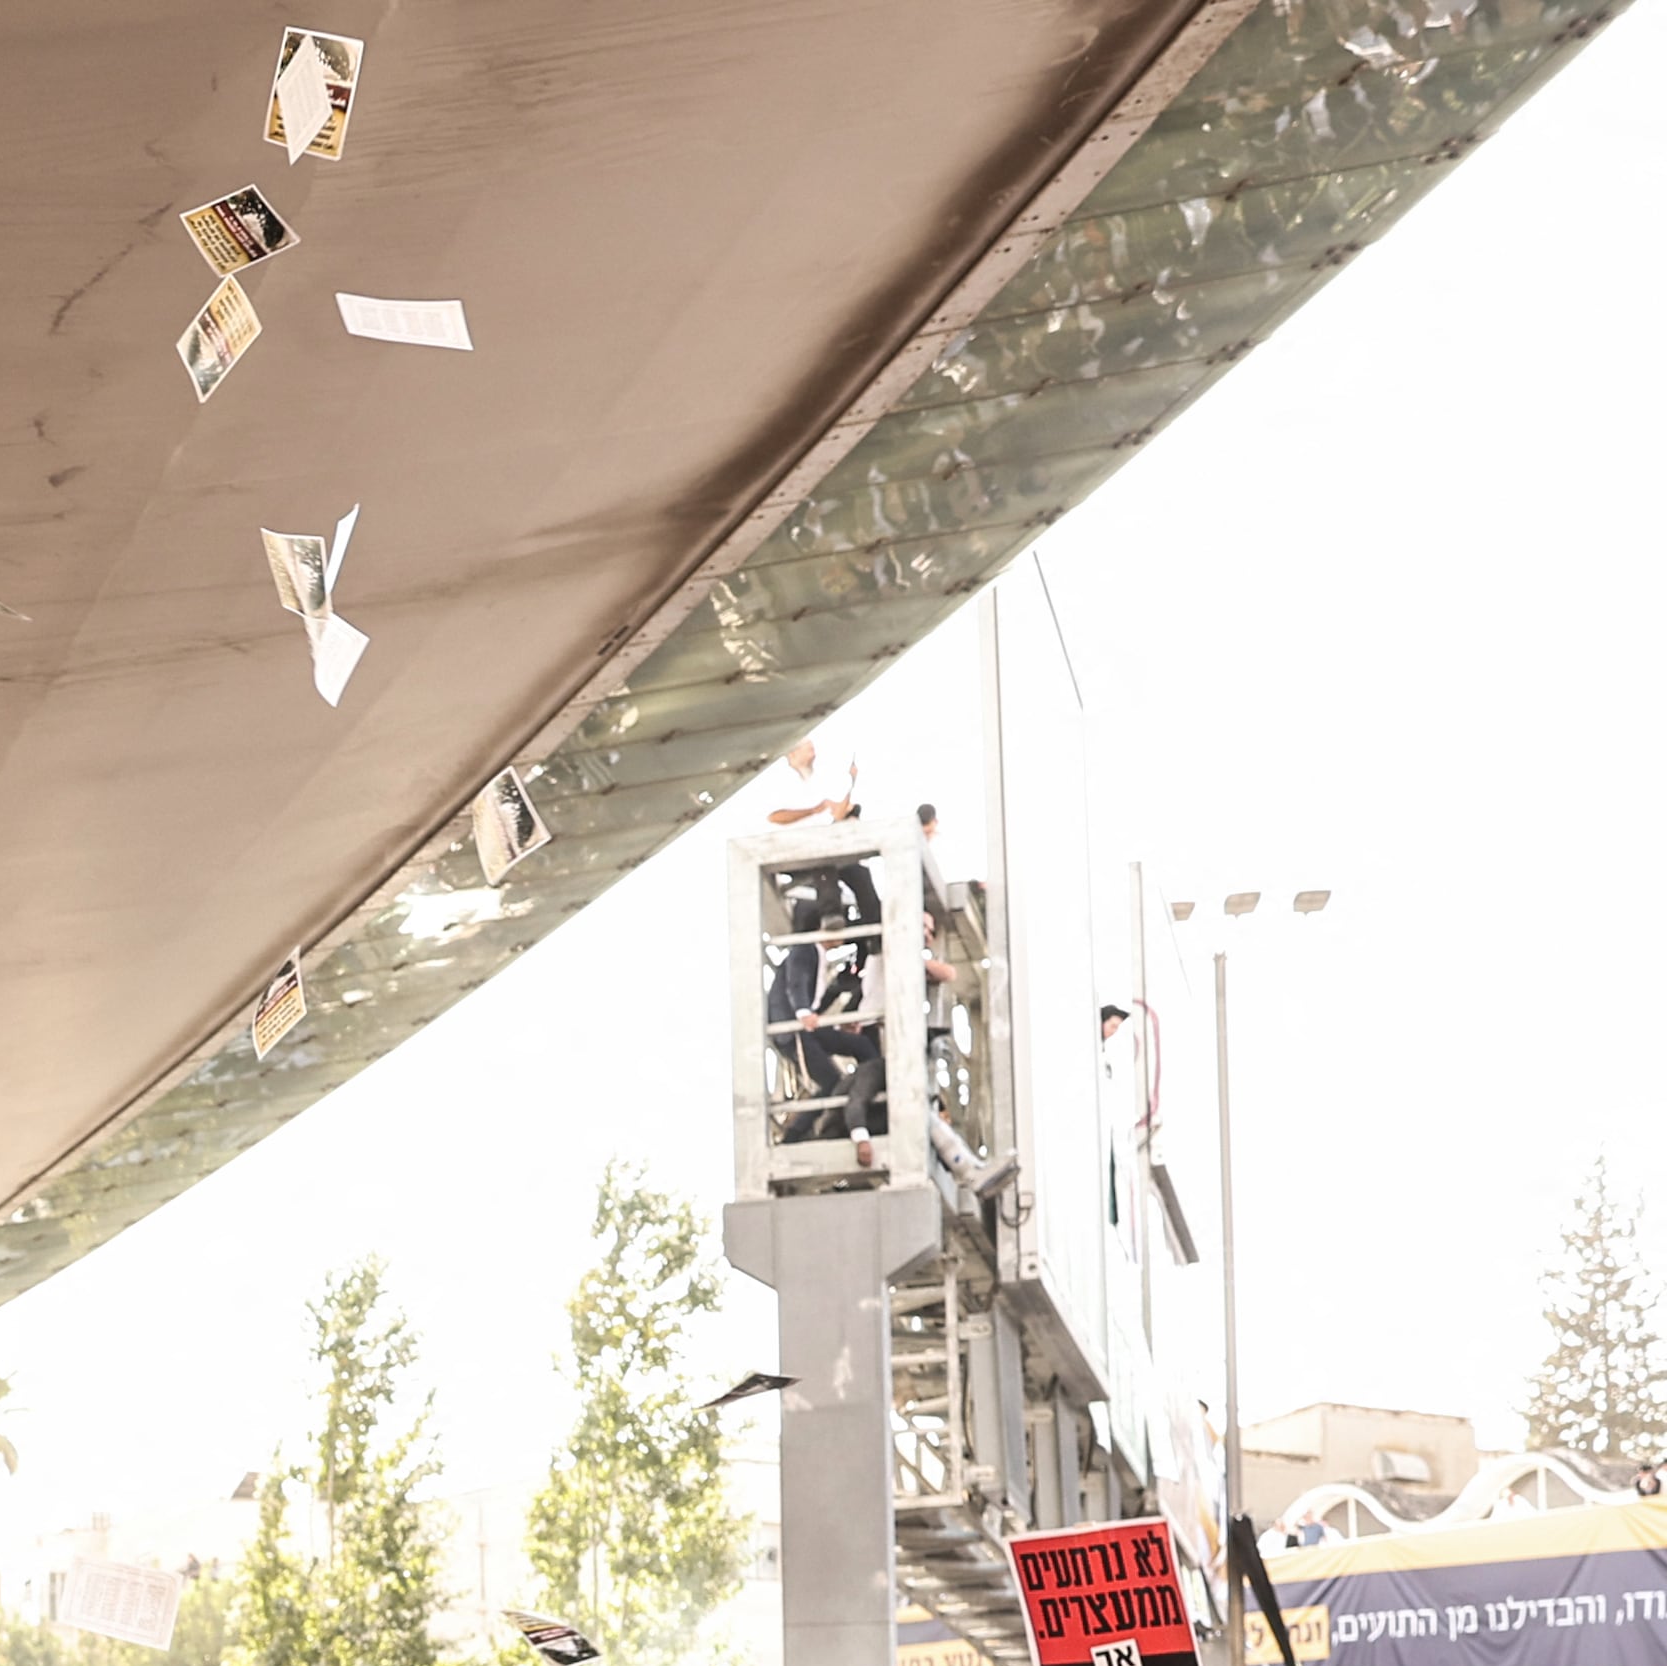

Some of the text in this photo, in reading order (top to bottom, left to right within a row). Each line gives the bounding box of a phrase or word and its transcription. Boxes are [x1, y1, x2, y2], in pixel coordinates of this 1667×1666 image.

[1021, 1531, 1170, 1591] לא נרתעים
[1038, 1586, 1182, 1639] ממעצרים.
[1445, 1605, 1478, 1641] מן
[1484, 1594, 1607, 1632] והבדילנו
[1615, 1590, 1667, 1626] ודו,
[1332, 1608, 1438, 1647] התועים,
